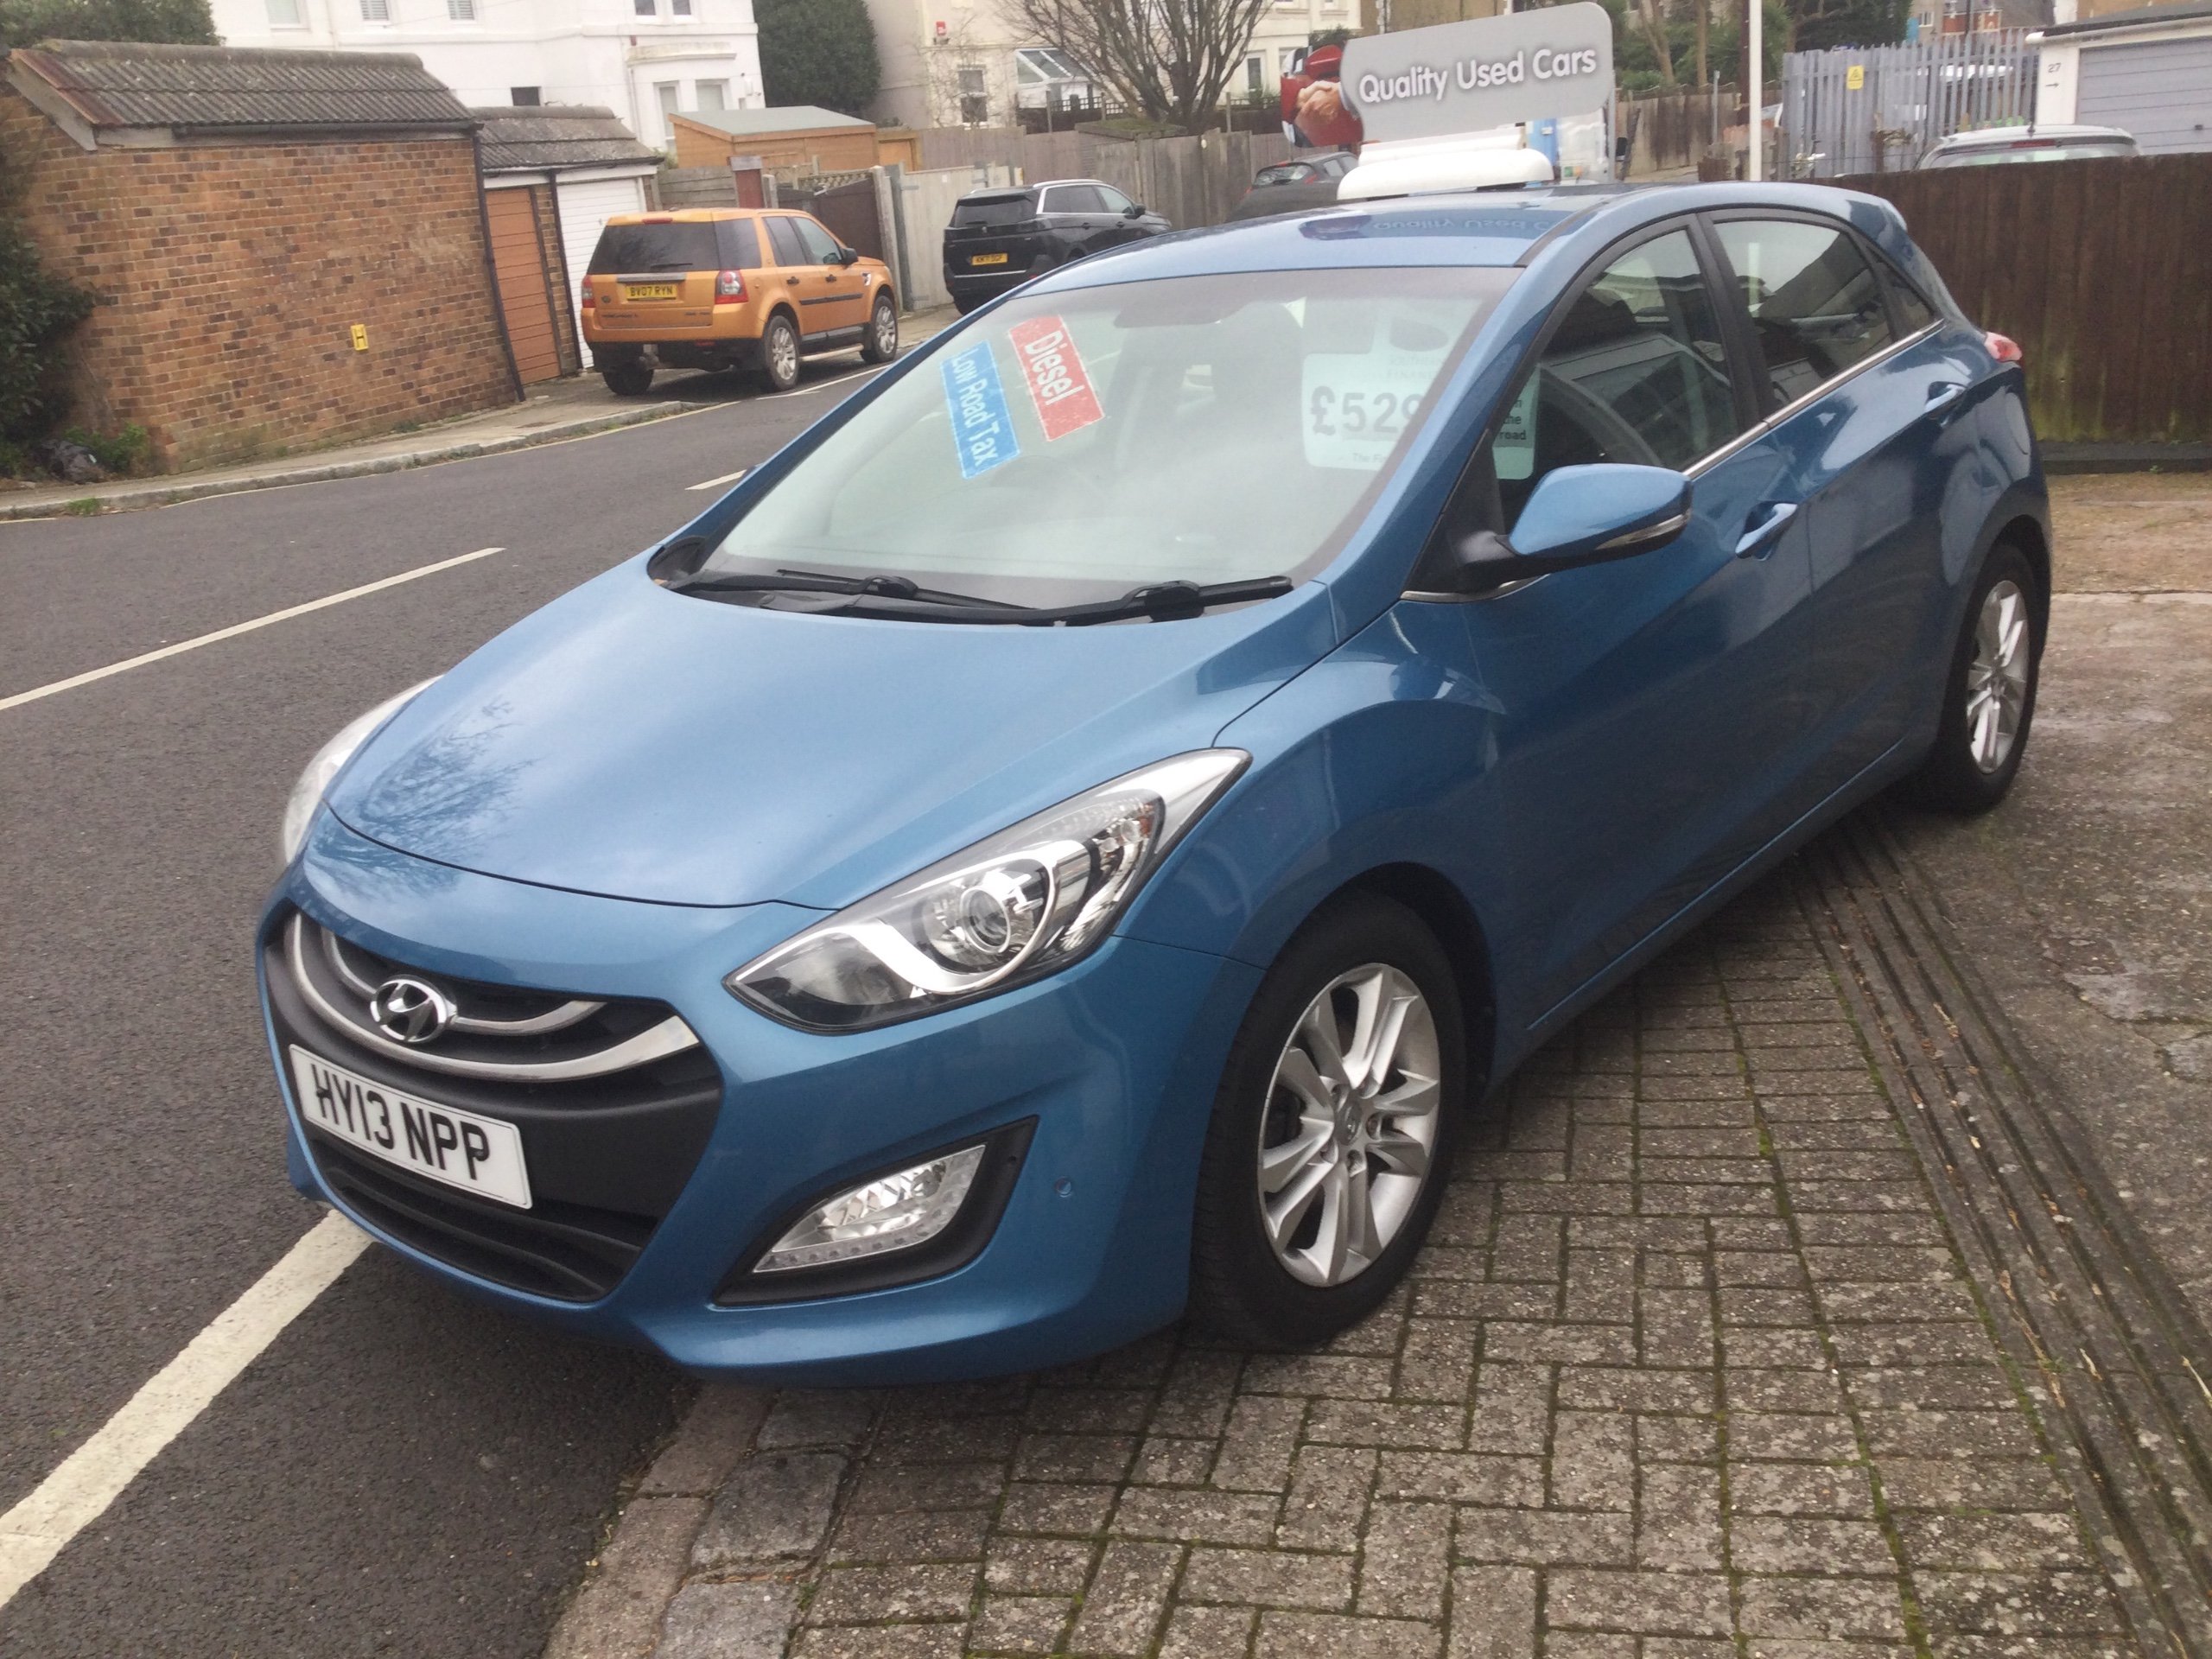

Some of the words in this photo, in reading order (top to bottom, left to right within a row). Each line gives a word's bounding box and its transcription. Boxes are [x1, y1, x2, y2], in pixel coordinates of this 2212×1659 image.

[1359, 66, 1447, 103] Quality
[1457, 50, 1524, 89] Used
[1532, 48, 1597, 79] Cars
[2047, 62, 2062, 73] 27
[630, 286, 652, 296] BV07
[654, 286, 673, 296] RYN
[951, 347, 979, 385] Low
[1024, 330, 1085, 405] Diesel
[958, 378, 995, 429] Road
[969, 420, 1001, 467] Tax
[311, 1064, 395, 1150] HY13
[400, 1102, 490, 1181] NPP
